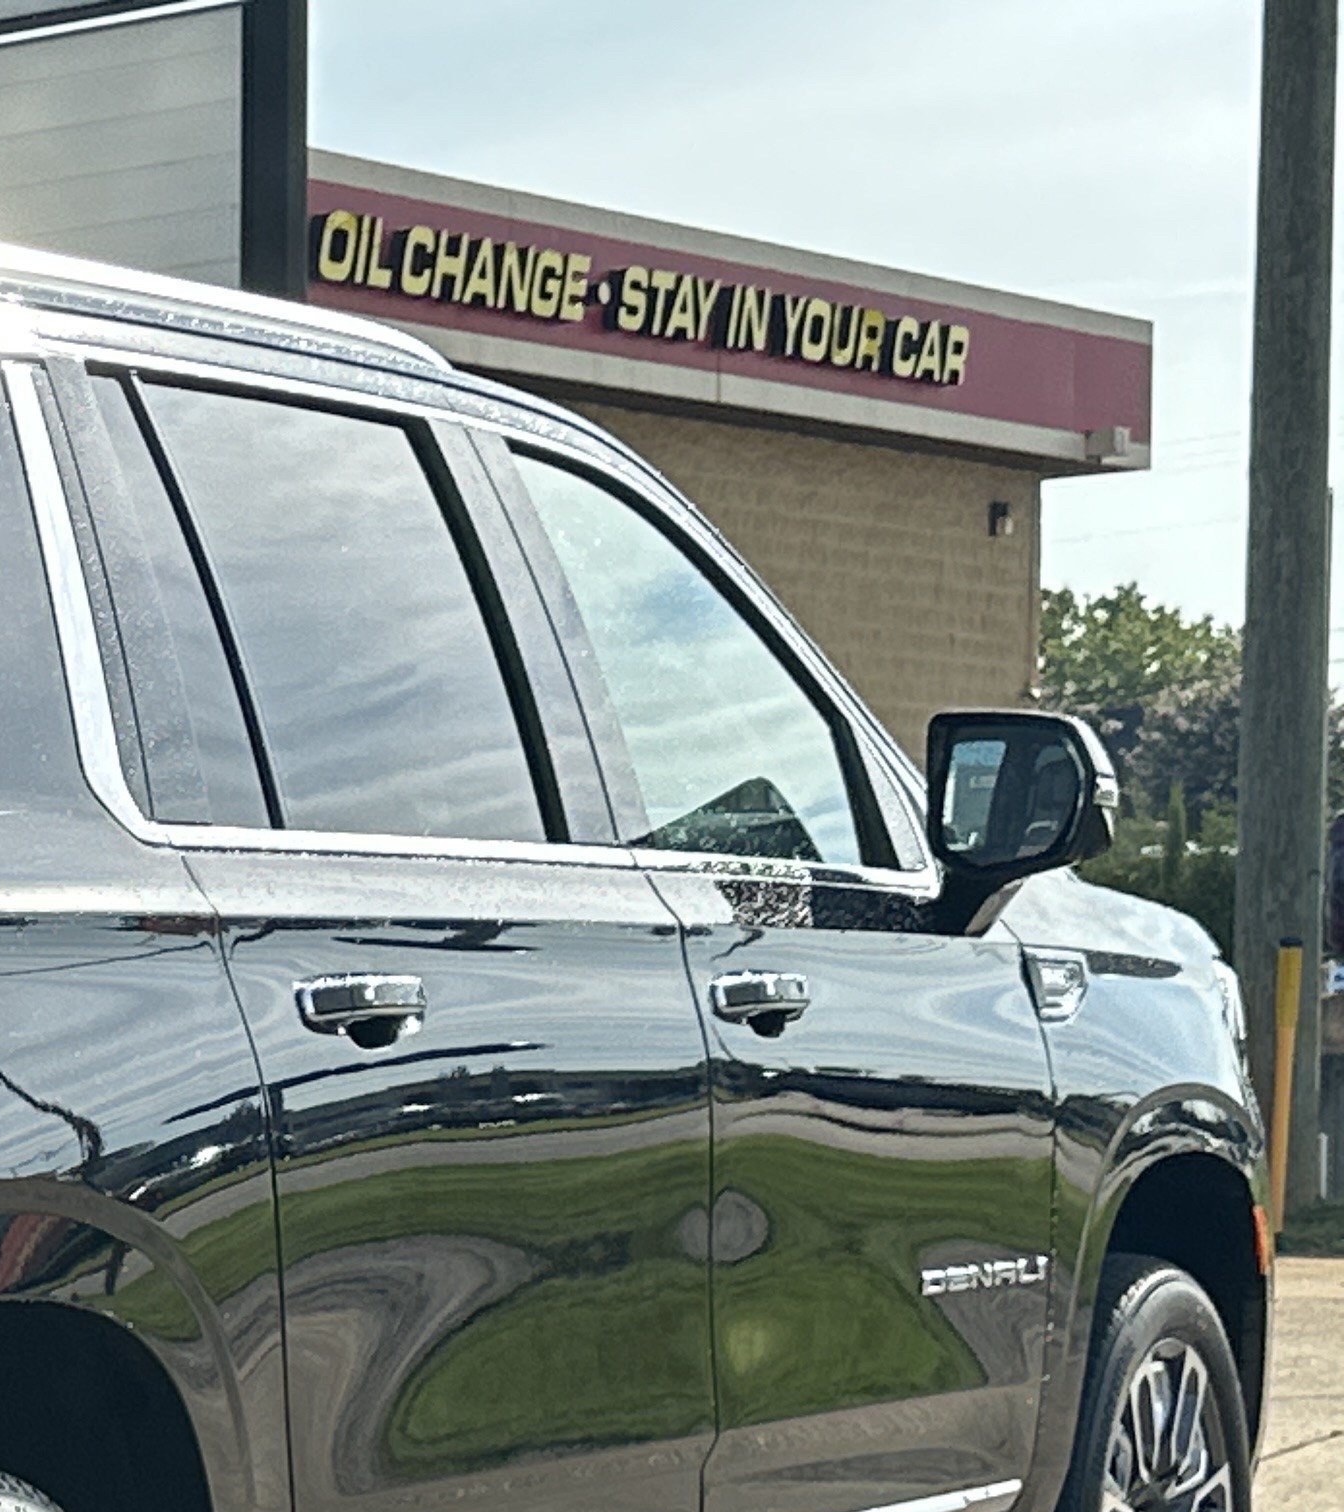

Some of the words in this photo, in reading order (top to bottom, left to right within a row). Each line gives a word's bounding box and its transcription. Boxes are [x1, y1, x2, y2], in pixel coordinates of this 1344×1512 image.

[318, 208, 393, 289] OIL
[400, 225, 592, 322] CHANGE
[617, 264, 721, 341] STAY
[726, 283, 771, 351] IN
[783, 293, 887, 372] YOUR
[892, 315, 970, 386] CAR
[921, 1254, 1050, 1297] DENALI
